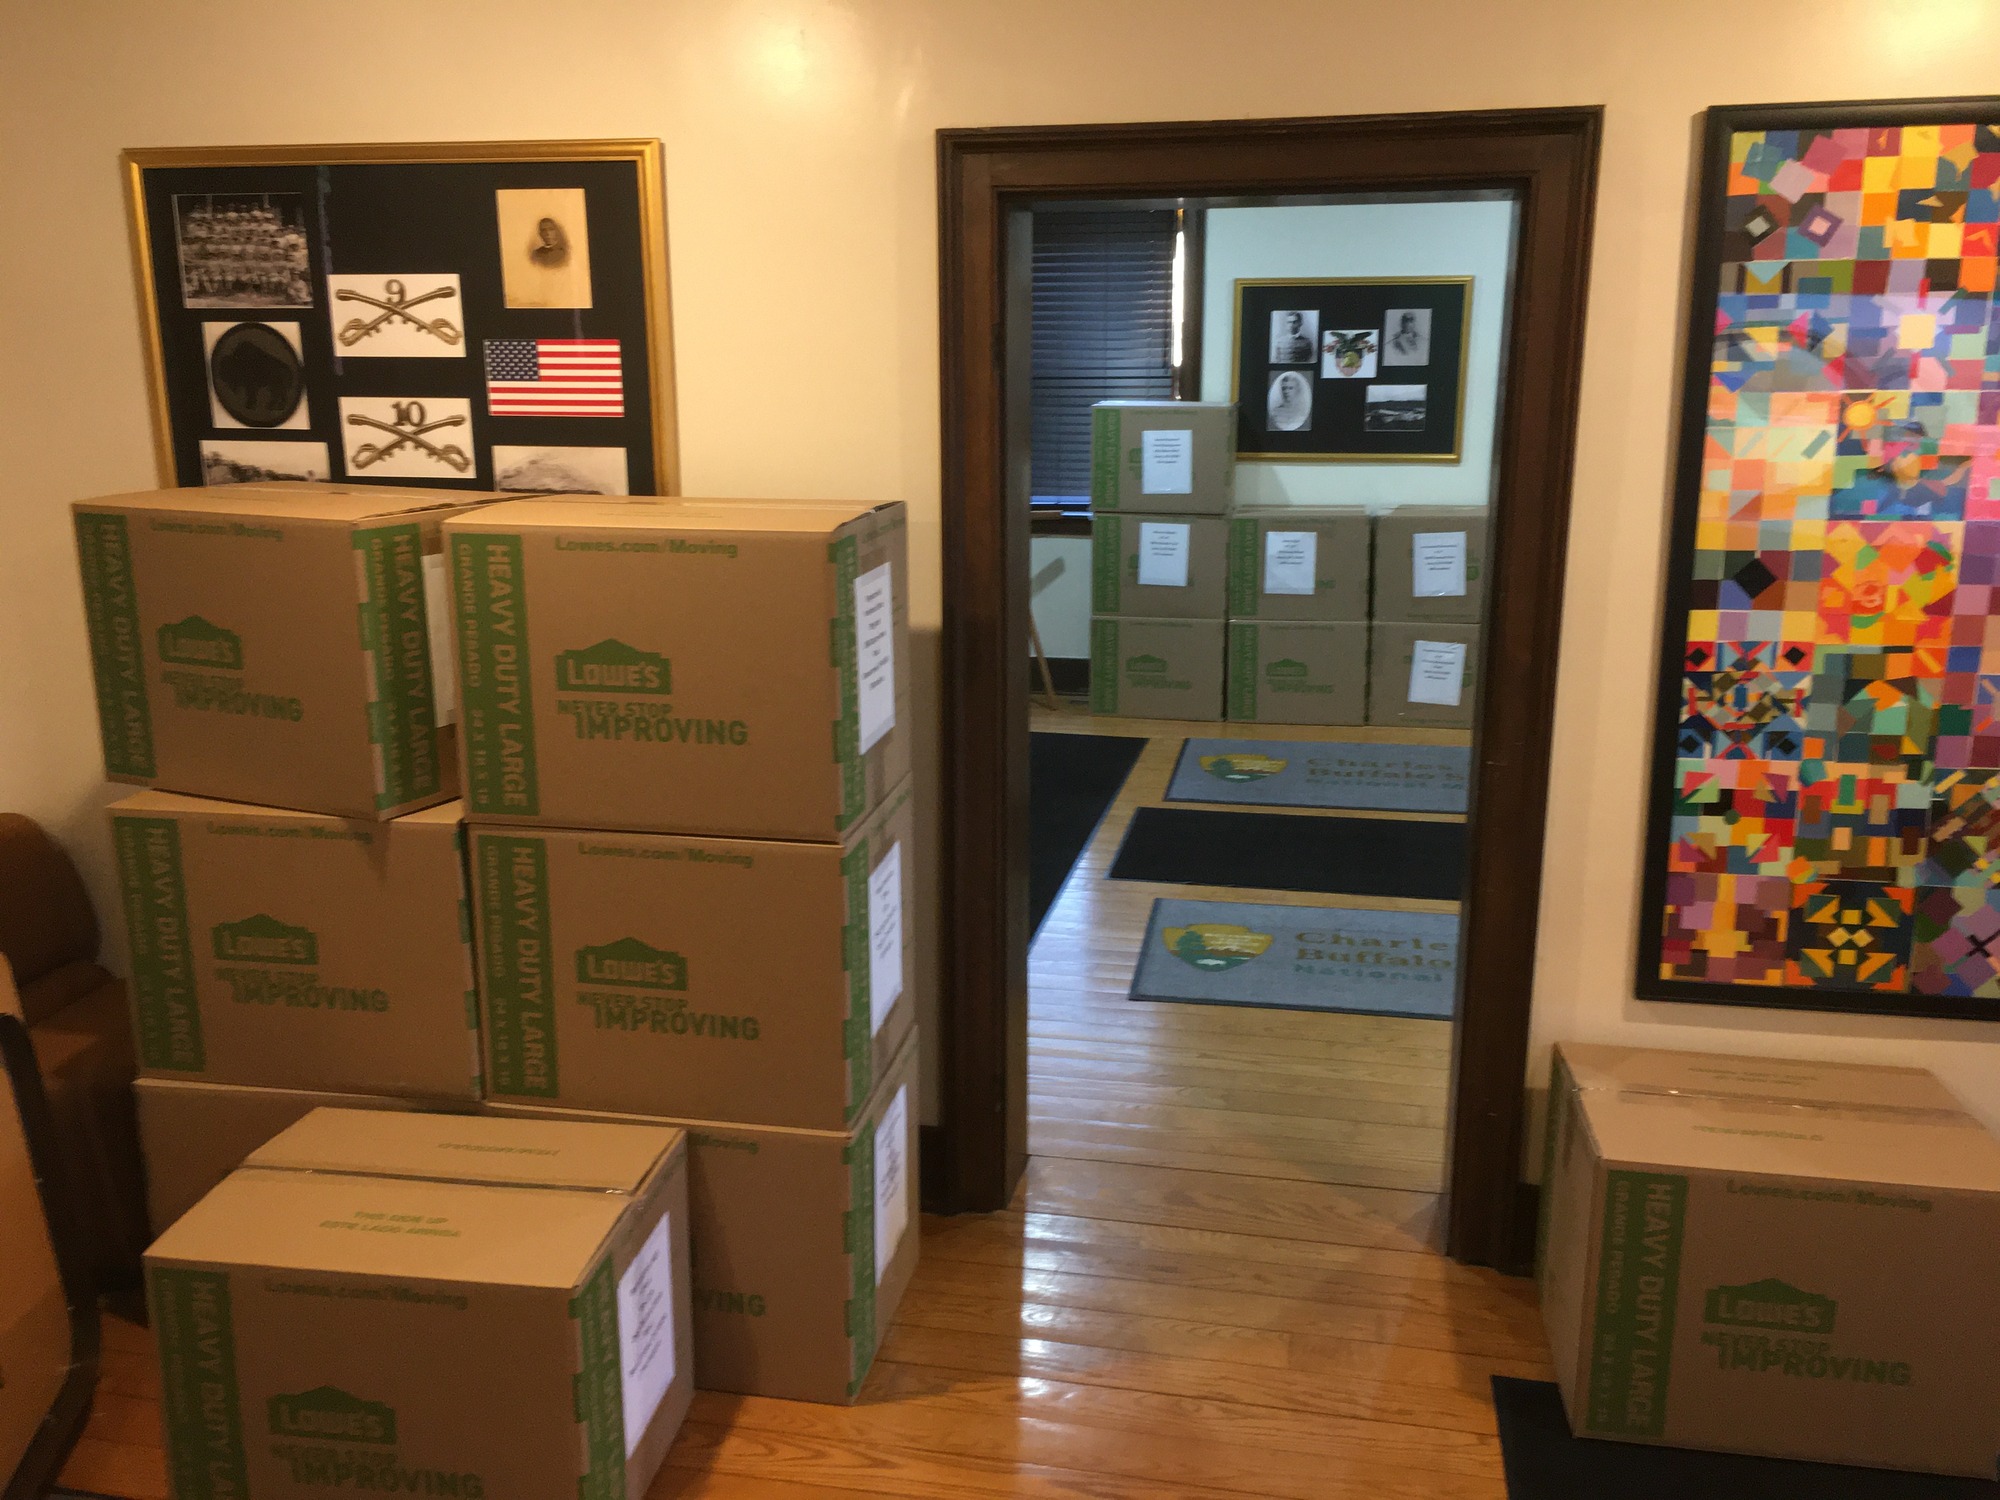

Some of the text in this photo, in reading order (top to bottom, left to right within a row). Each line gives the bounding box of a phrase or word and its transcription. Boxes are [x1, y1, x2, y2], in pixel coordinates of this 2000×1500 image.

[385, 278, 407, 303] 9
[391, 400, 427, 428] 10
[100, 523, 129, 608] HEAVY
[456, 542, 477, 613] GRANDE
[111, 615, 137, 682] DUTY
[392, 533, 433, 792] HEAVY DUTY LARGE
[483, 543, 528, 807] HEAVY DUTY LARGE
[557, 699, 674, 719] NEVER STOP
[574, 712, 750, 746] IMPROVING
[144, 826, 195, 1063] HEAVY DUTY LARGE
[509, 845, 548, 1090] HEAVY DUTY LARGE
[594, 1004, 762, 1041] IMPROVING
[189, 1280, 225, 1374] HEAVY
[1623, 1182, 1674, 1427] HEAVY DUTY LARGE
[1717, 1346, 1913, 1387] IMPROVING
[199, 1382, 233, 1454] DUTY
[290, 1457, 485, 1498] IMPROVING
